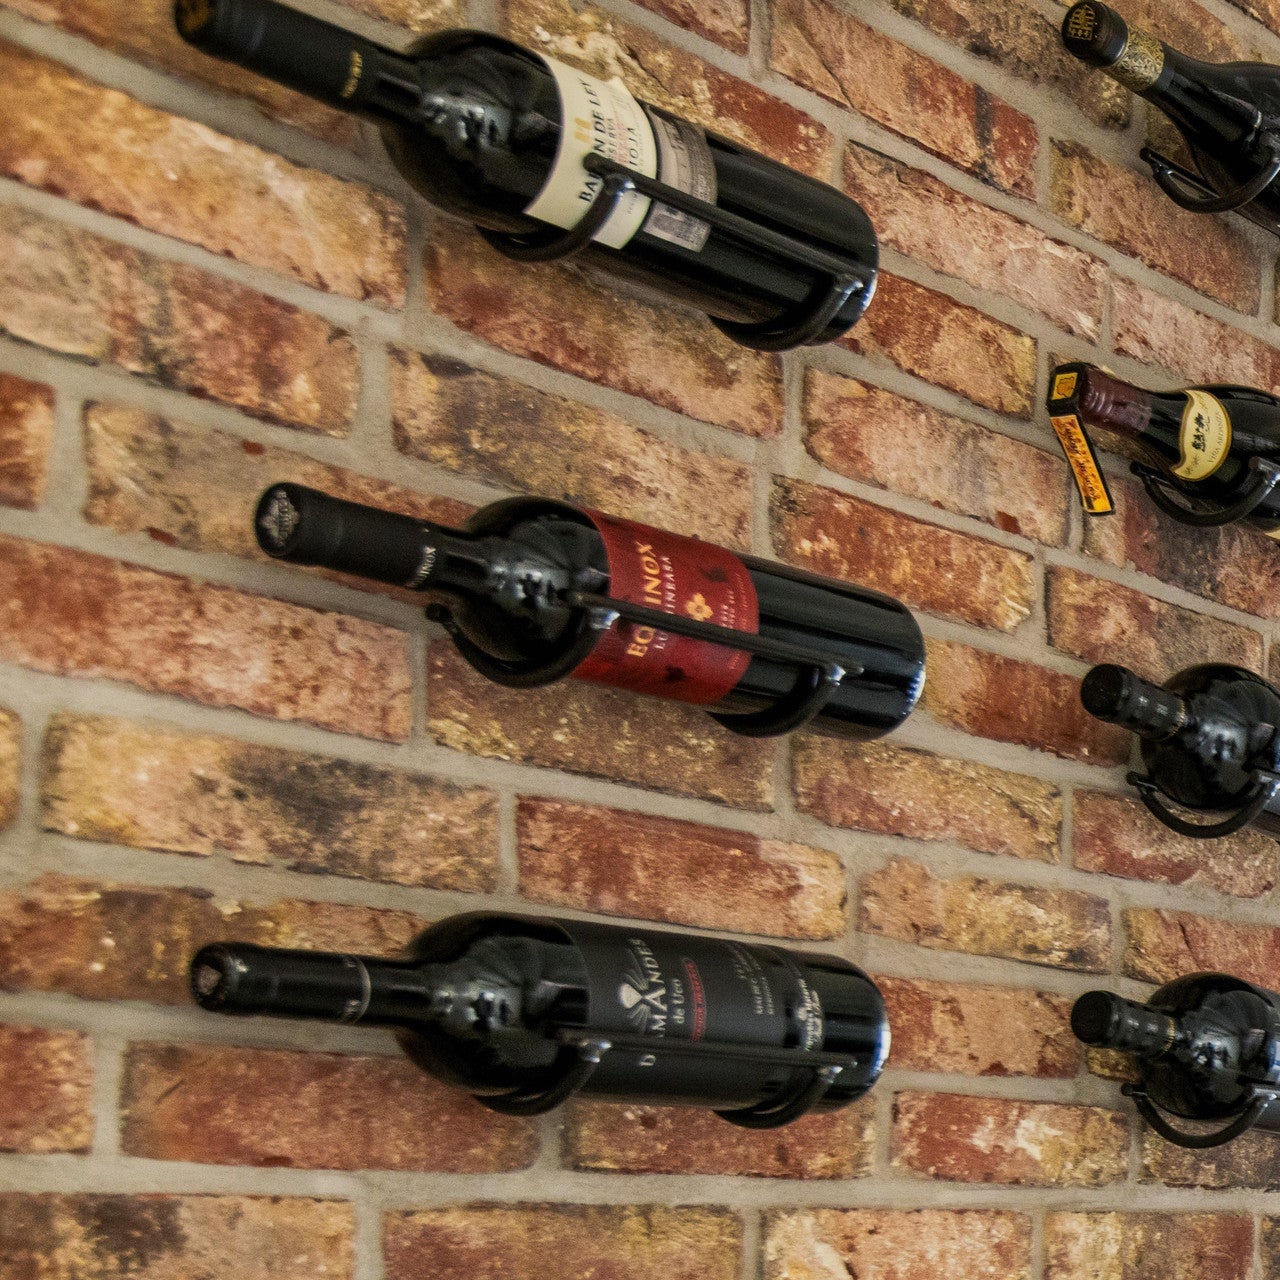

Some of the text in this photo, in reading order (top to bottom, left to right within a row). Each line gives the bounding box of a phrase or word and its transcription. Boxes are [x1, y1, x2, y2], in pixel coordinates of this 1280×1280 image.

[577, 78, 600, 105] LEY
[594, 112, 605, 133] DE
[627, 127, 637, 166] IOJA
[627, 540, 660, 658] EQINOX
[629, 938, 669, 1066] DMANDES
[671, 979, 685, 1023] de Uco
